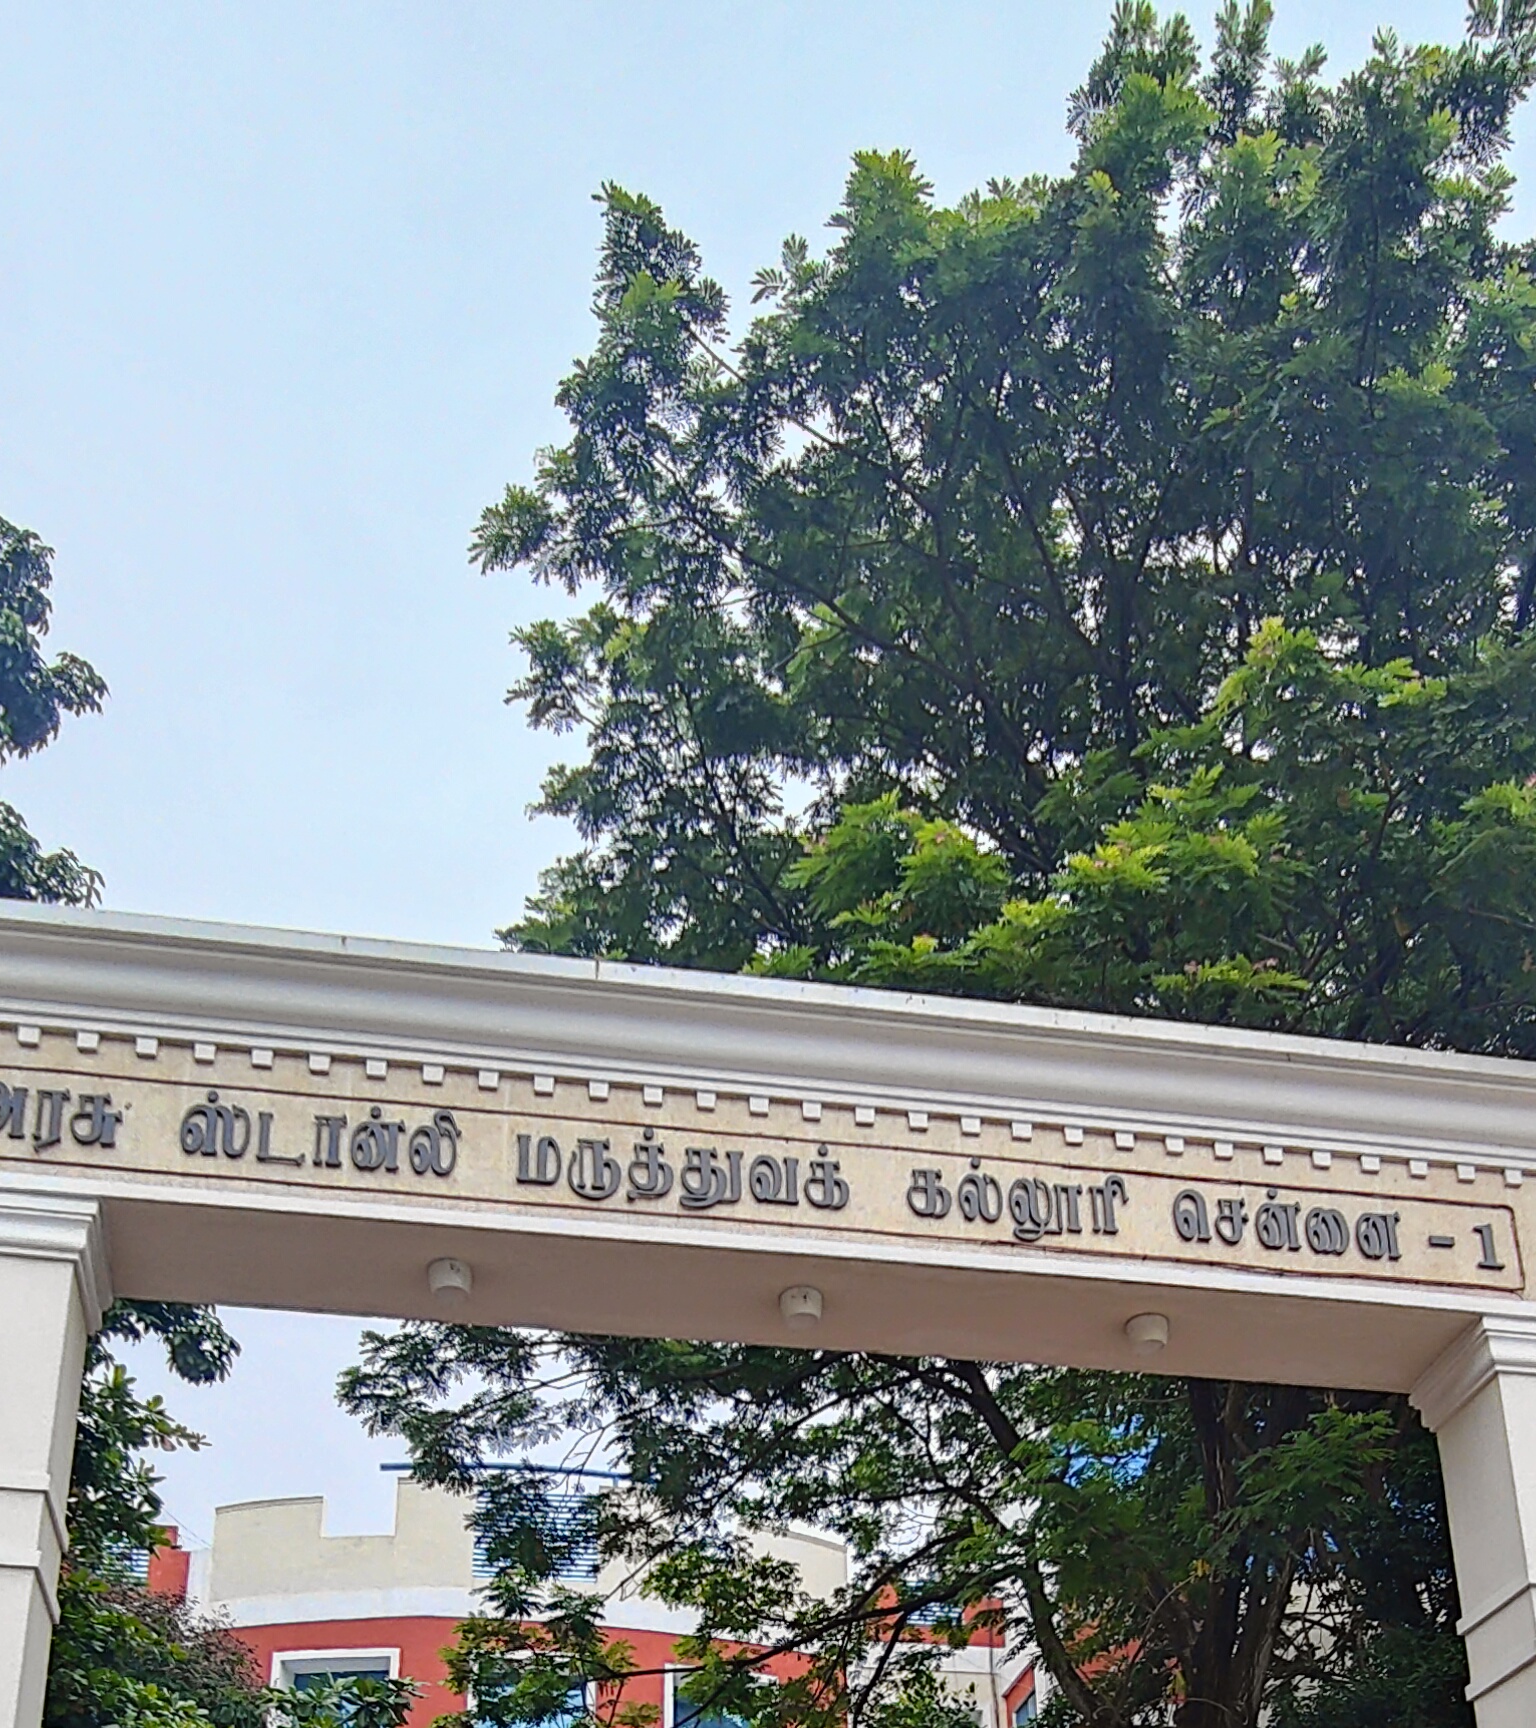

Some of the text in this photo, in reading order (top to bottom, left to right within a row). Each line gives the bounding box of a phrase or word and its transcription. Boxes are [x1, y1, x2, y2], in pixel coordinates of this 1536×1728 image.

[178, 1090, 463, 1178] ஸ்டான்லி
[515, 1125, 852, 1209] மருத்துவக்
[906, 1155, 1130, 1243] கல்லூரி
[1173, 1187, 1401, 1261] சென்னை
